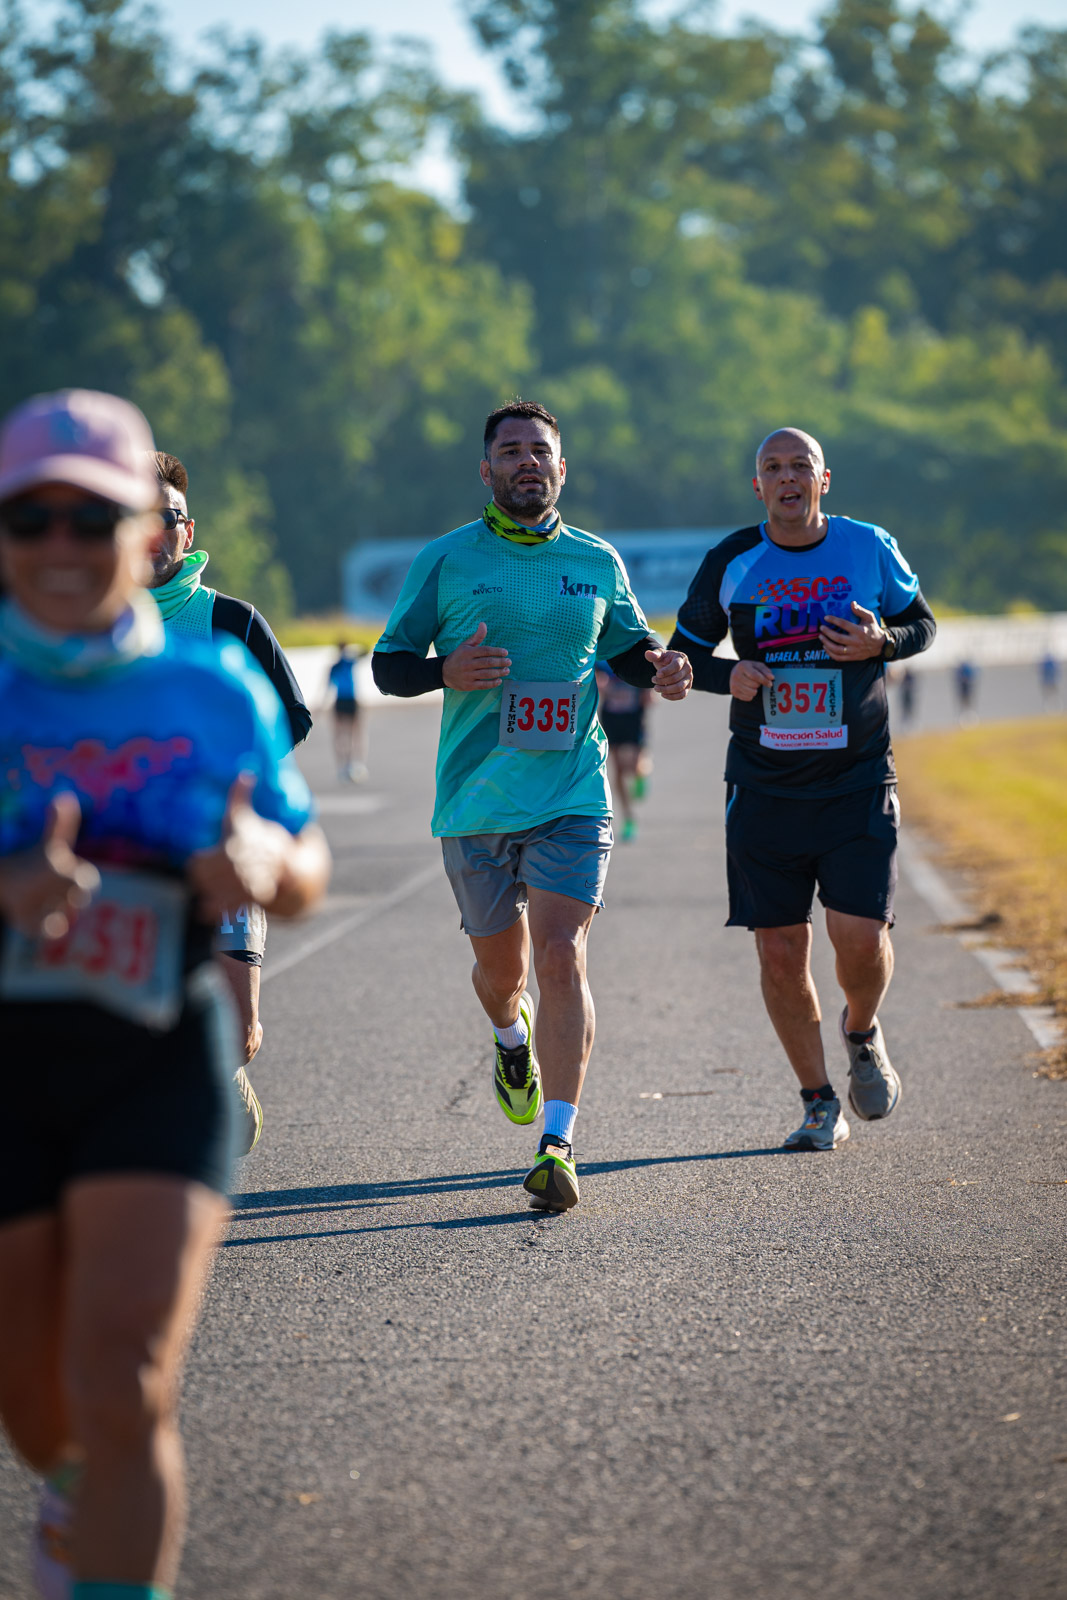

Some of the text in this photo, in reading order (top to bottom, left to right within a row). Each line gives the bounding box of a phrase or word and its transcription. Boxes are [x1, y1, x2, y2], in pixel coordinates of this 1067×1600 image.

[472, 586, 503, 596] INVICTO
[560, 575, 598, 596] km
[822, 584, 852, 593] MILLAS
[777, 682, 828, 714] 357
[506, 694, 517, 734] TIEMPO
[517, 697, 570, 733] 335
[569, 694, 577, 734] EXACTO
[763, 727, 843, 741] Prevención Salud
